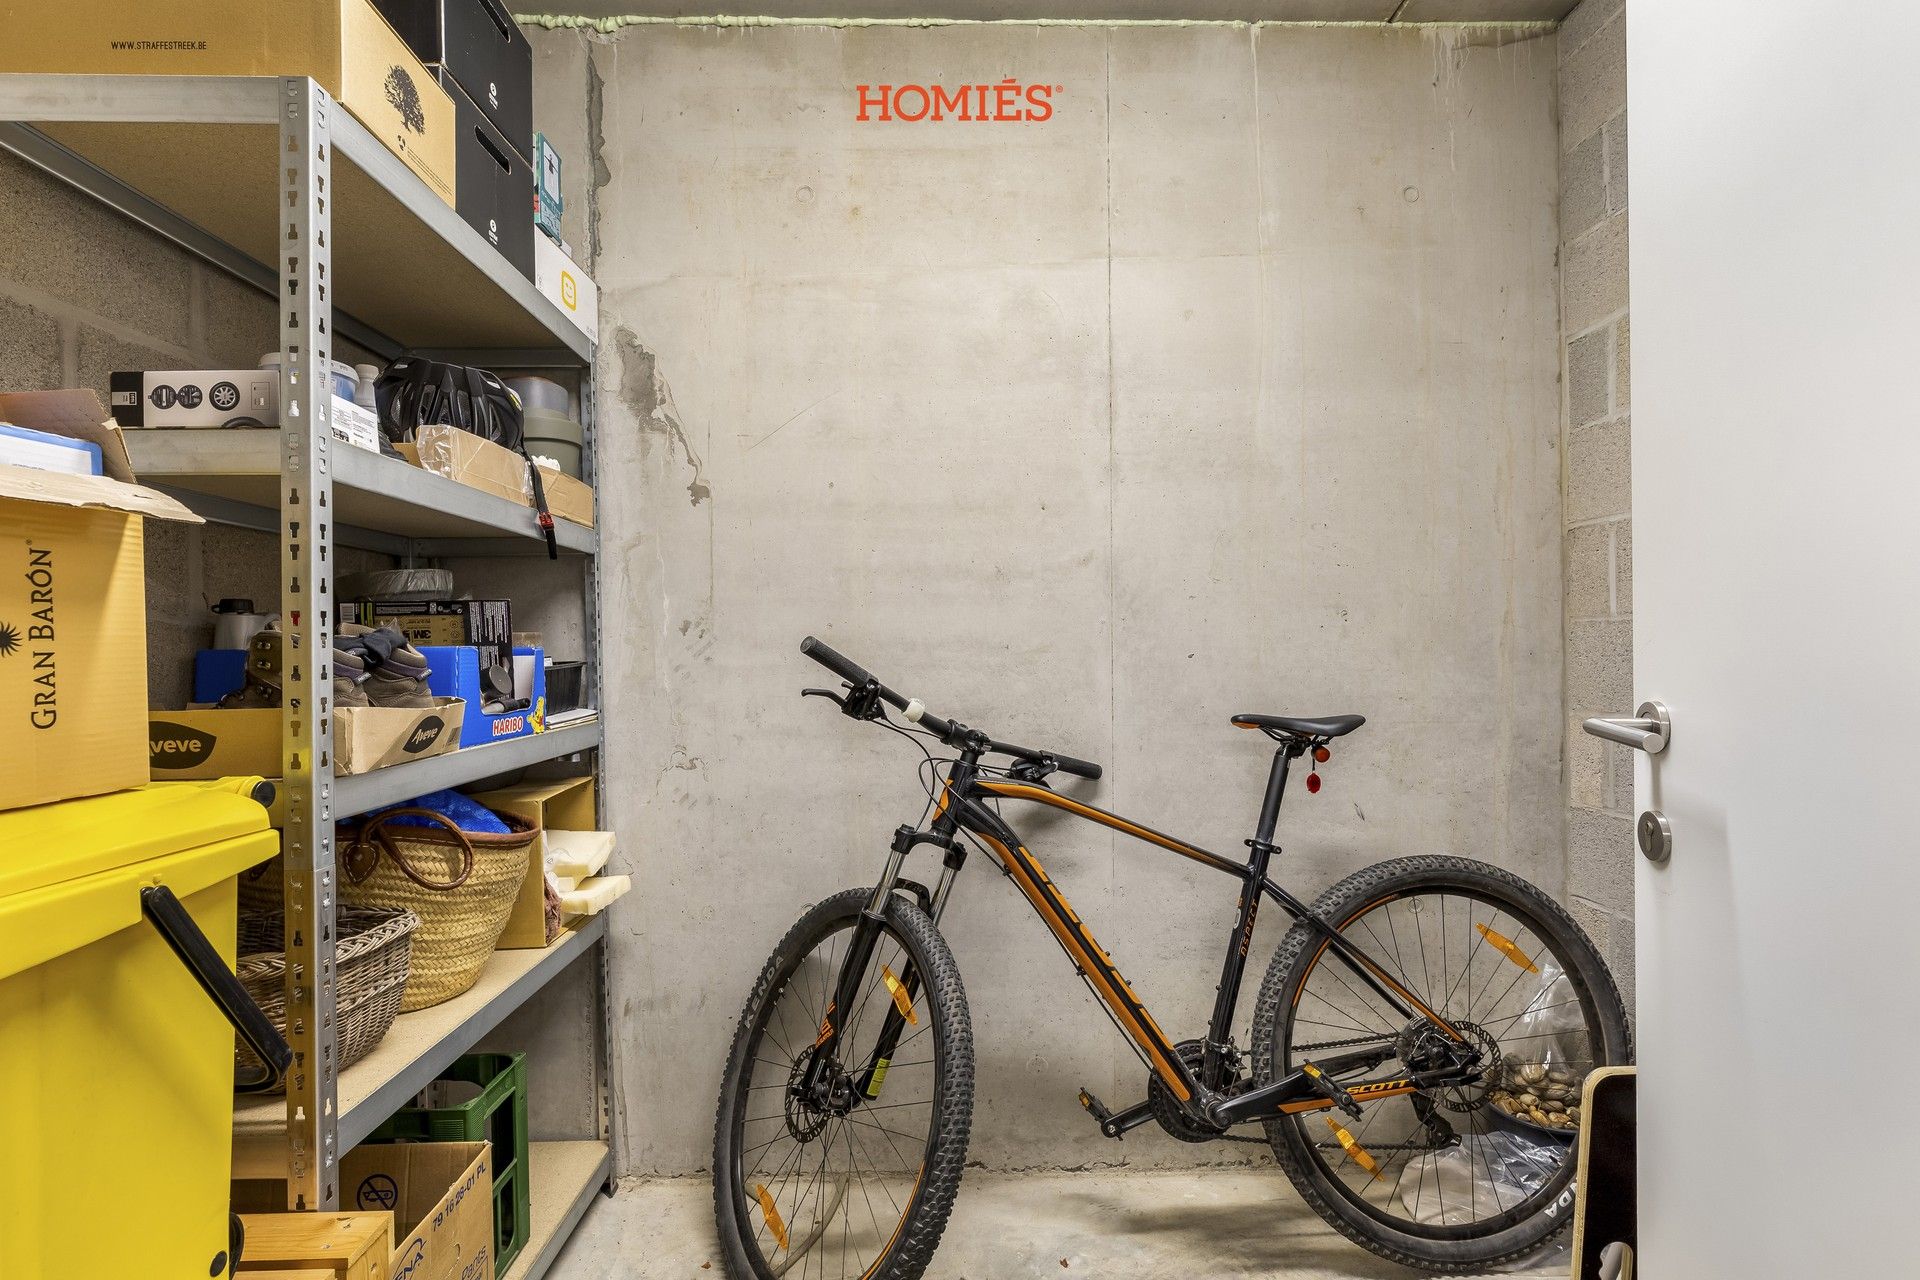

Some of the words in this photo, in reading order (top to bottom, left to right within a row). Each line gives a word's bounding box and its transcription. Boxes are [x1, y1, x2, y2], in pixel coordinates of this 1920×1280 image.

[111, 41, 207, 50] WWW.STRAFFESTREEK.BE
[25, 547, 55, 641] BARÓN
[30, 651, 57, 729] GRAN
[492, 716, 524, 737] HARIBO
[149, 739, 202, 757] veve
[744, 955, 784, 1029] KENDA
[1345, 1079, 1410, 1095] SCOTT
